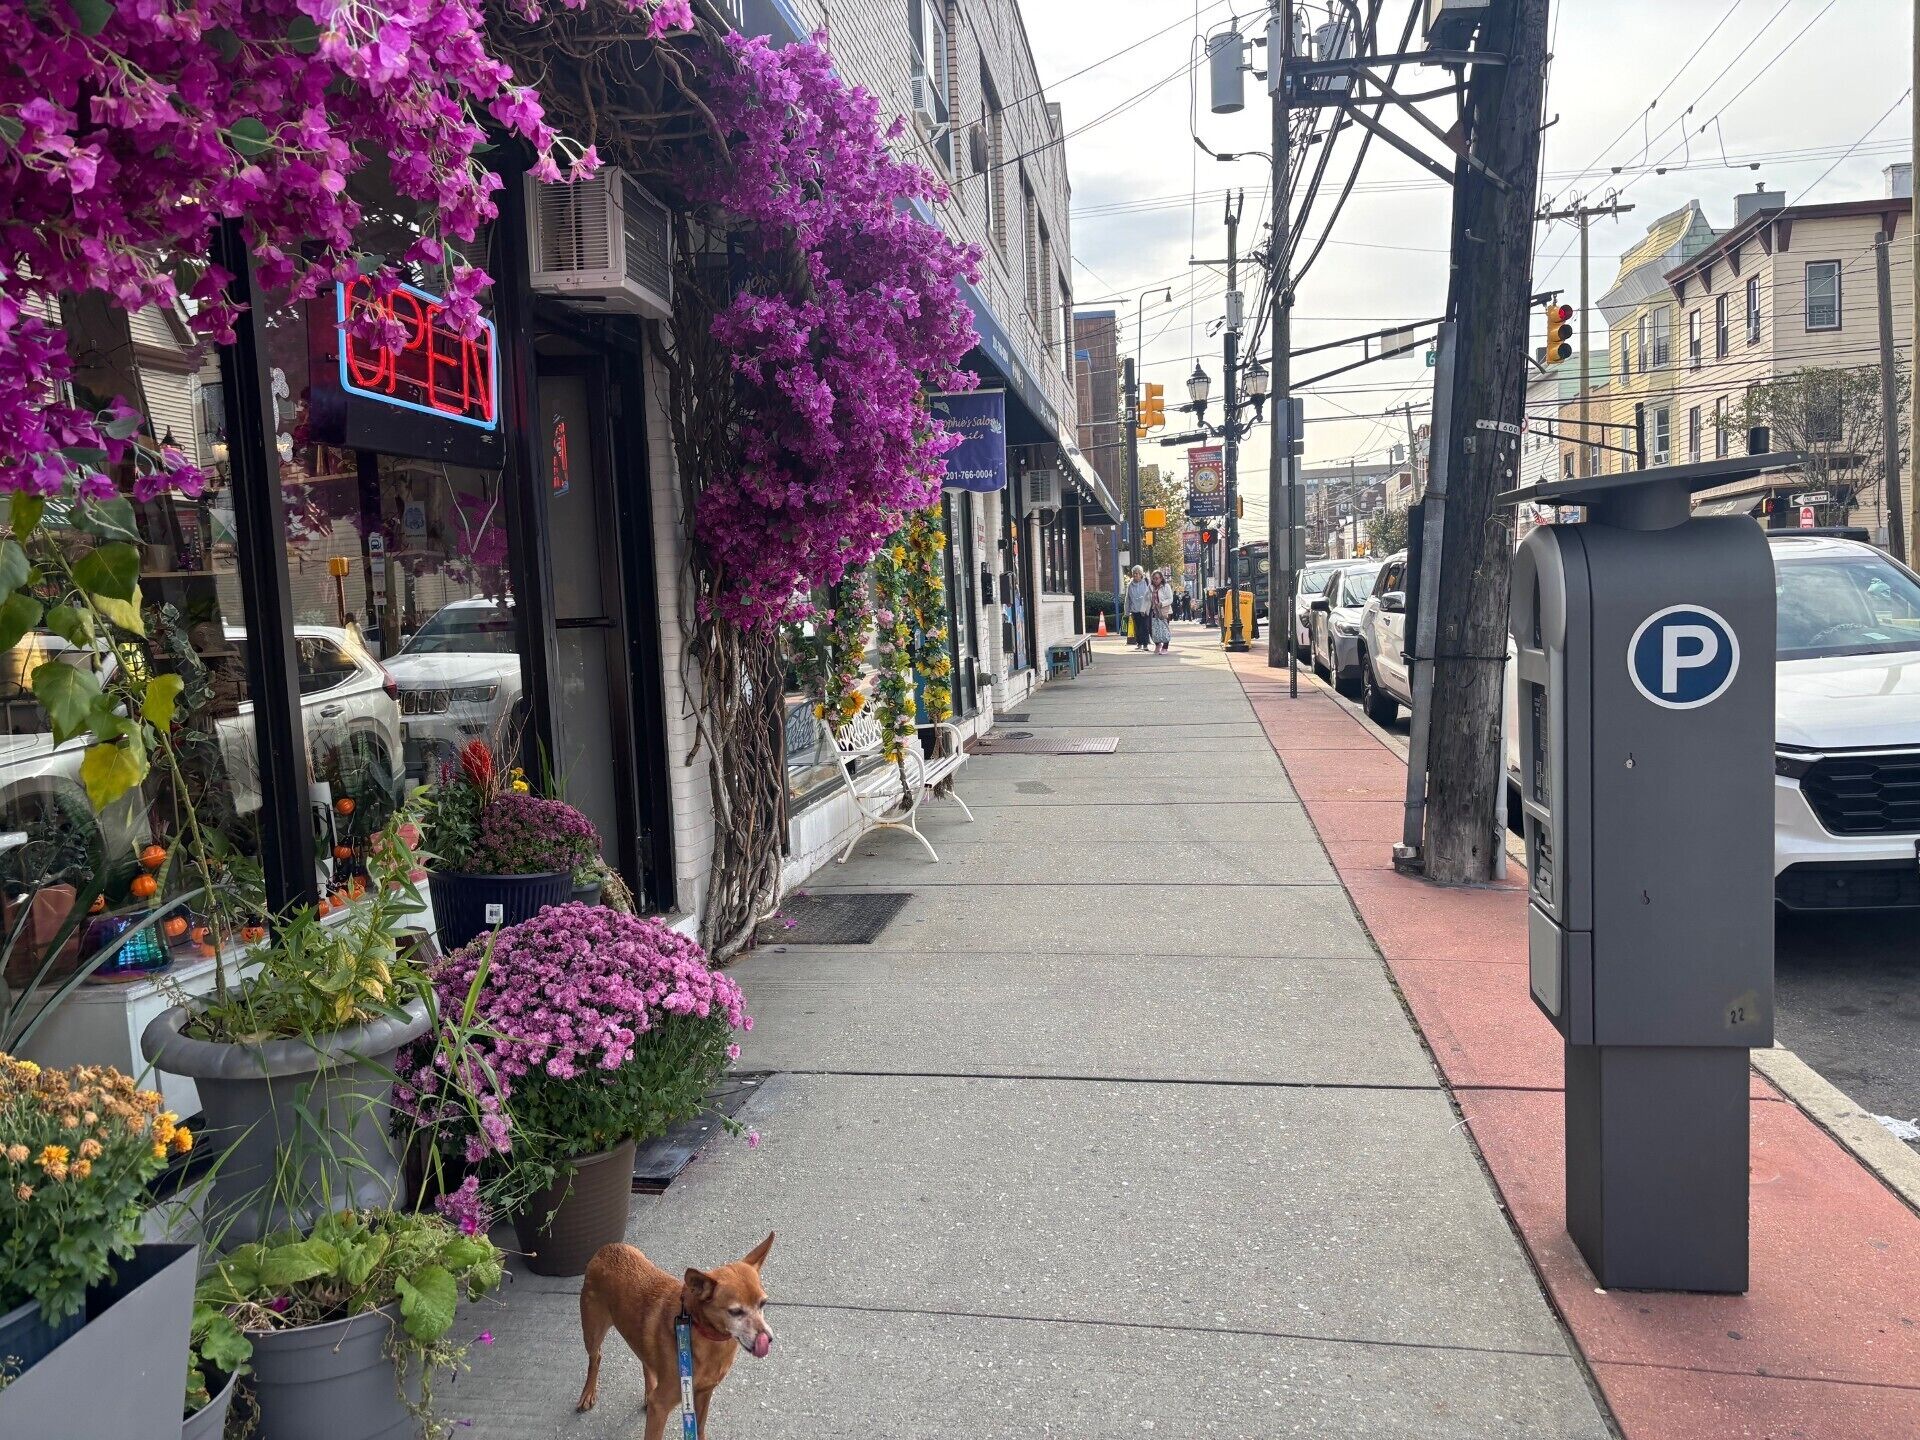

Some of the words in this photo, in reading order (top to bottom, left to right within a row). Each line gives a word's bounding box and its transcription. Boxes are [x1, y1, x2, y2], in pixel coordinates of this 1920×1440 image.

[344, 273, 494, 423] OPEN
[943, 416, 972, 431] ophie's
[946, 470, 993, 481] 201-766-0004
[1661, 623, 1719, 695] P
[1729, 1006, 1746, 1026] 22
